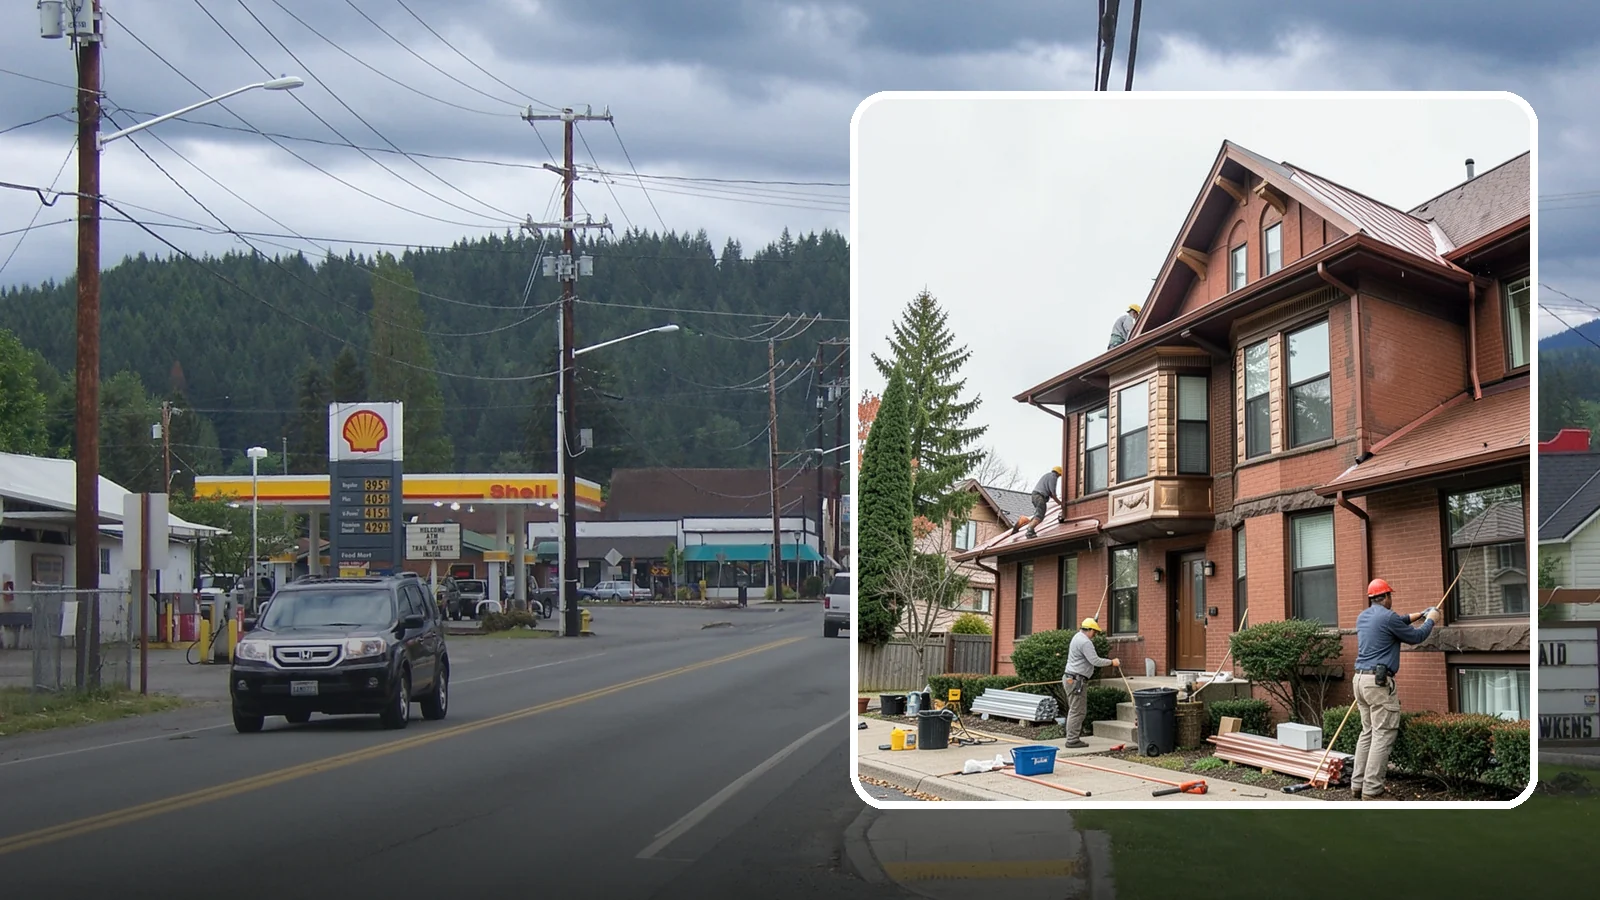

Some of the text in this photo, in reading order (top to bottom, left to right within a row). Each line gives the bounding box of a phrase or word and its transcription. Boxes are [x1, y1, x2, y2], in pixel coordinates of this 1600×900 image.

[366, 480, 384, 490] 395
[490, 484, 547, 499] Shell
[366, 494, 384, 504] 405
[366, 508, 384, 518] 415
[366, 522, 384, 533] 429
